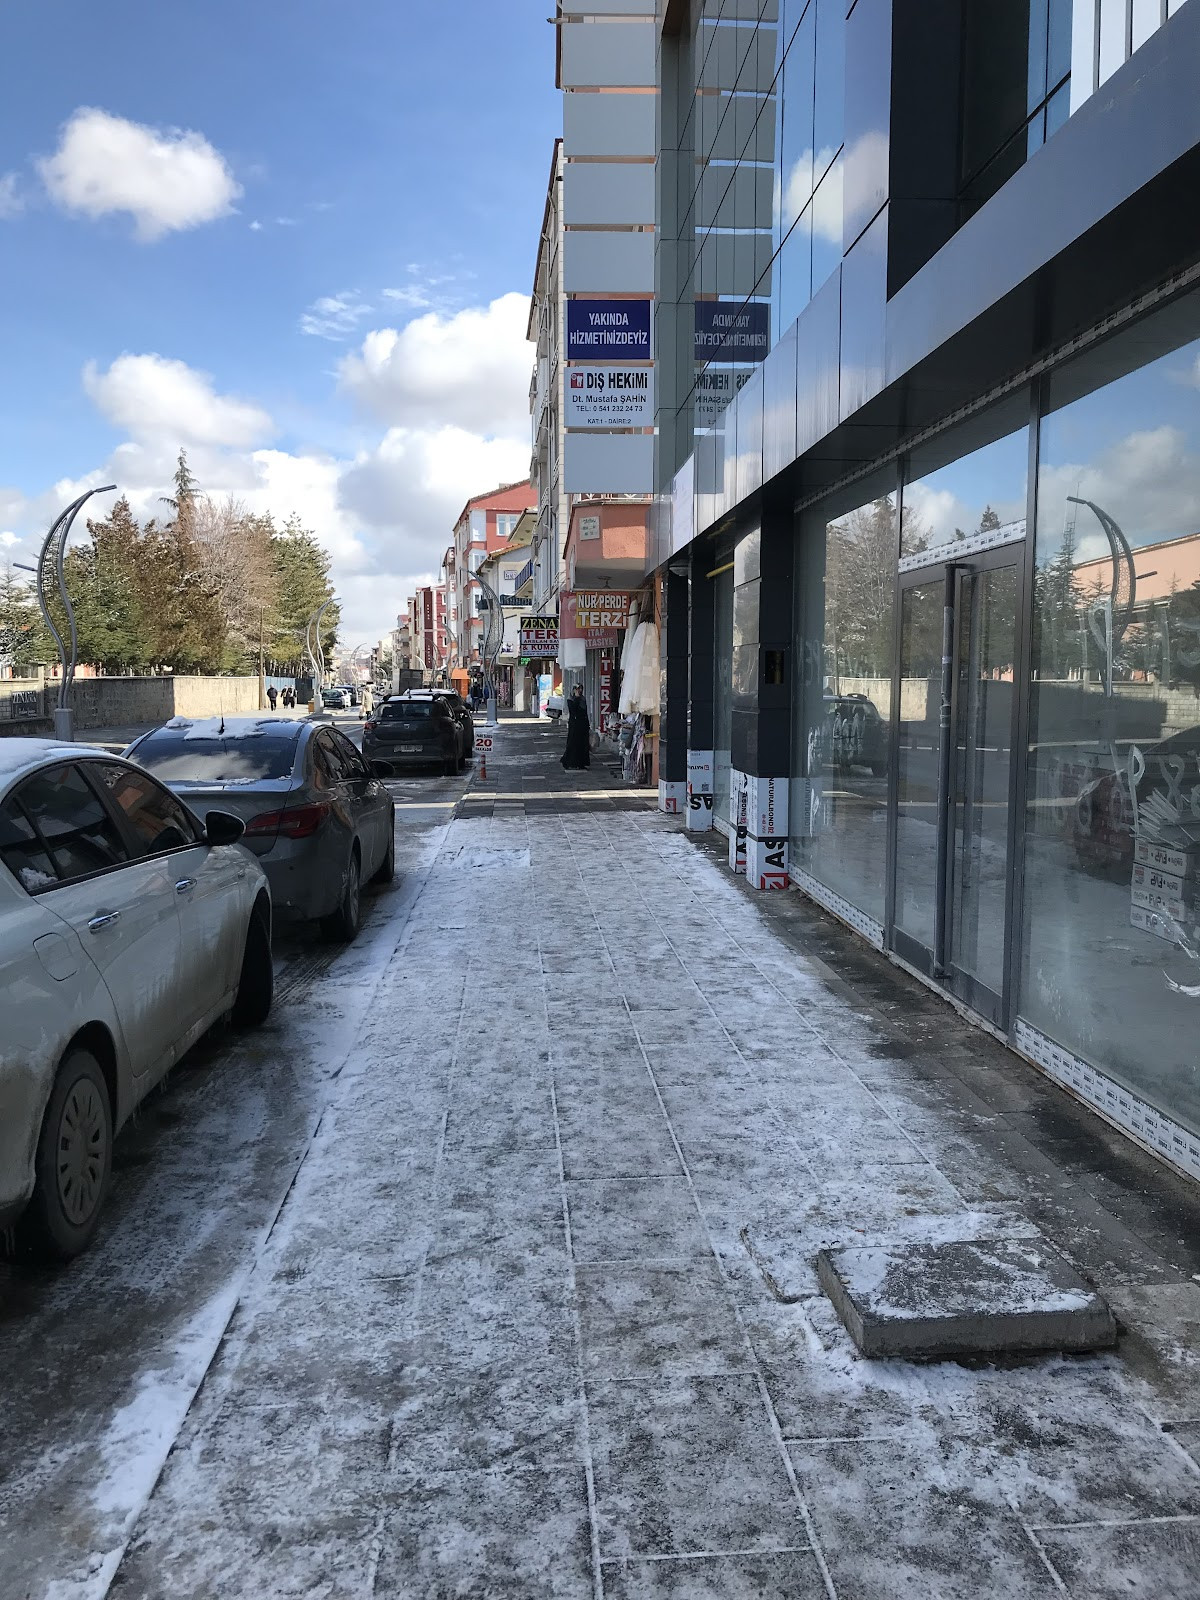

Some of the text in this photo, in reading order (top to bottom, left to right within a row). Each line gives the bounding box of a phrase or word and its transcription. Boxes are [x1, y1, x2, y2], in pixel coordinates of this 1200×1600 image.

[588, 312, 630, 326] YAKINDA
[569, 329, 648, 345] HİZMETİNİZDEYİZ
[572, 393, 647, 404] Dt. Mustafa ŞAHİN
[578, 594, 628, 609] NUR PERDE
[522, 618, 560, 629] ZENA
[522, 629, 560, 640] TER
[475, 738, 493, 747] 20
